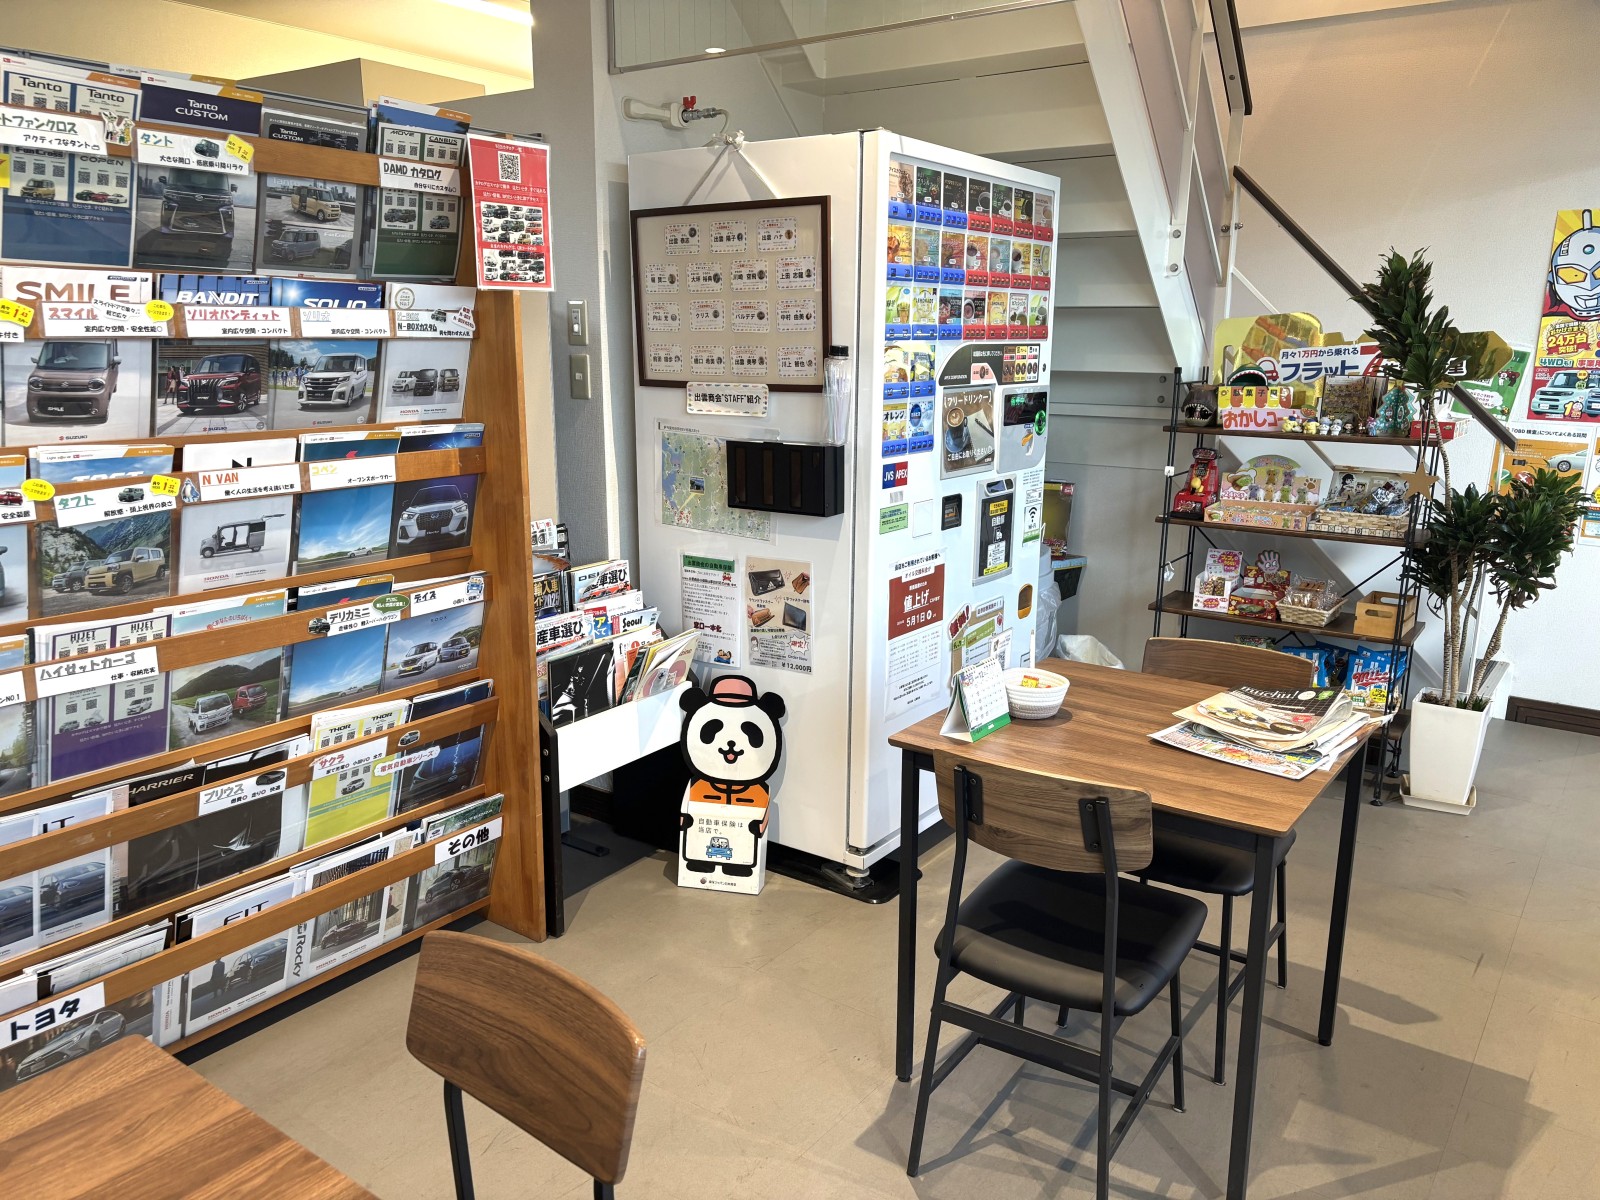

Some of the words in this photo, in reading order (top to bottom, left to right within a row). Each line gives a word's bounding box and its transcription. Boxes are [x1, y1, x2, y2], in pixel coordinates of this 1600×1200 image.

[19, 76, 62, 93] Tanto
[86, 88, 125, 104] Tanto
[187, 99, 219, 111] Tanto
[175, 107, 228, 122] CUSTOM
[0, 111, 78, 135] トファンクロス
[272, 132, 304, 142] CUSTOM
[279, 127, 298, 136] Tanto
[389, 130, 416, 138] MOVE
[140, 132, 174, 147] タント
[428, 135, 458, 146] CANBUS
[79, 154, 125, 168] COPEN
[383, 162, 408, 176] DAMD
[410, 167, 442, 181] カタログ
[16, 281, 130, 303] SMILE
[176, 291, 260, 305] BANDIT
[49, 307, 99, 320] スマイル
[187, 308, 281, 321] ソリオバンディット
[303, 311, 331, 322] ソリオ
[1548, 331, 1588, 347] 24万台
[1281, 347, 1359, 360] 月々1万円から乗れる
[1281, 360, 1360, 384] フラット
[883, 410, 906, 422] オレンジ
[311, 464, 338, 476] コペン
[883, 470, 895, 482] JVS
[895, 468, 908, 480] APEX
[202, 474, 211, 485] N
[217, 472, 240, 484] VAN
[58, 495, 95, 509] タフト
[203, 573, 229, 582] HONDA
[600, 566, 628, 587] 車選び
[534, 579, 558, 596] 輸入車
[904, 588, 930, 612] 値上げ
[329, 608, 371, 625] デリカミニ
[622, 615, 643, 629] Seoul
[906, 611, 926, 627] 5月1日
[130, 620, 154, 631] HIJET
[693, 621, 722, 633] 窓口一本化
[70, 630, 97, 641] HIJET
[536, 620, 584, 646] 産車選び
[40, 652, 137, 681] ハイゼットカーゴ
[371, 711, 393, 722] THOR
[328, 723, 352, 734] THOR
[318, 753, 345, 769] サクラ
[380, 751, 434, 773] 電気自動車シリーズ
[128, 772, 195, 796] HARRIER
[204, 783, 245, 804] プリウス
[698, 817, 744, 829] 自動車保険は
[447, 826, 490, 856] その他
[223, 900, 270, 926] FIT
[315, 958, 337, 971] HONDA
[10, 997, 81, 1042] トヨタ
[207, 1006, 232, 1020] HONDA
